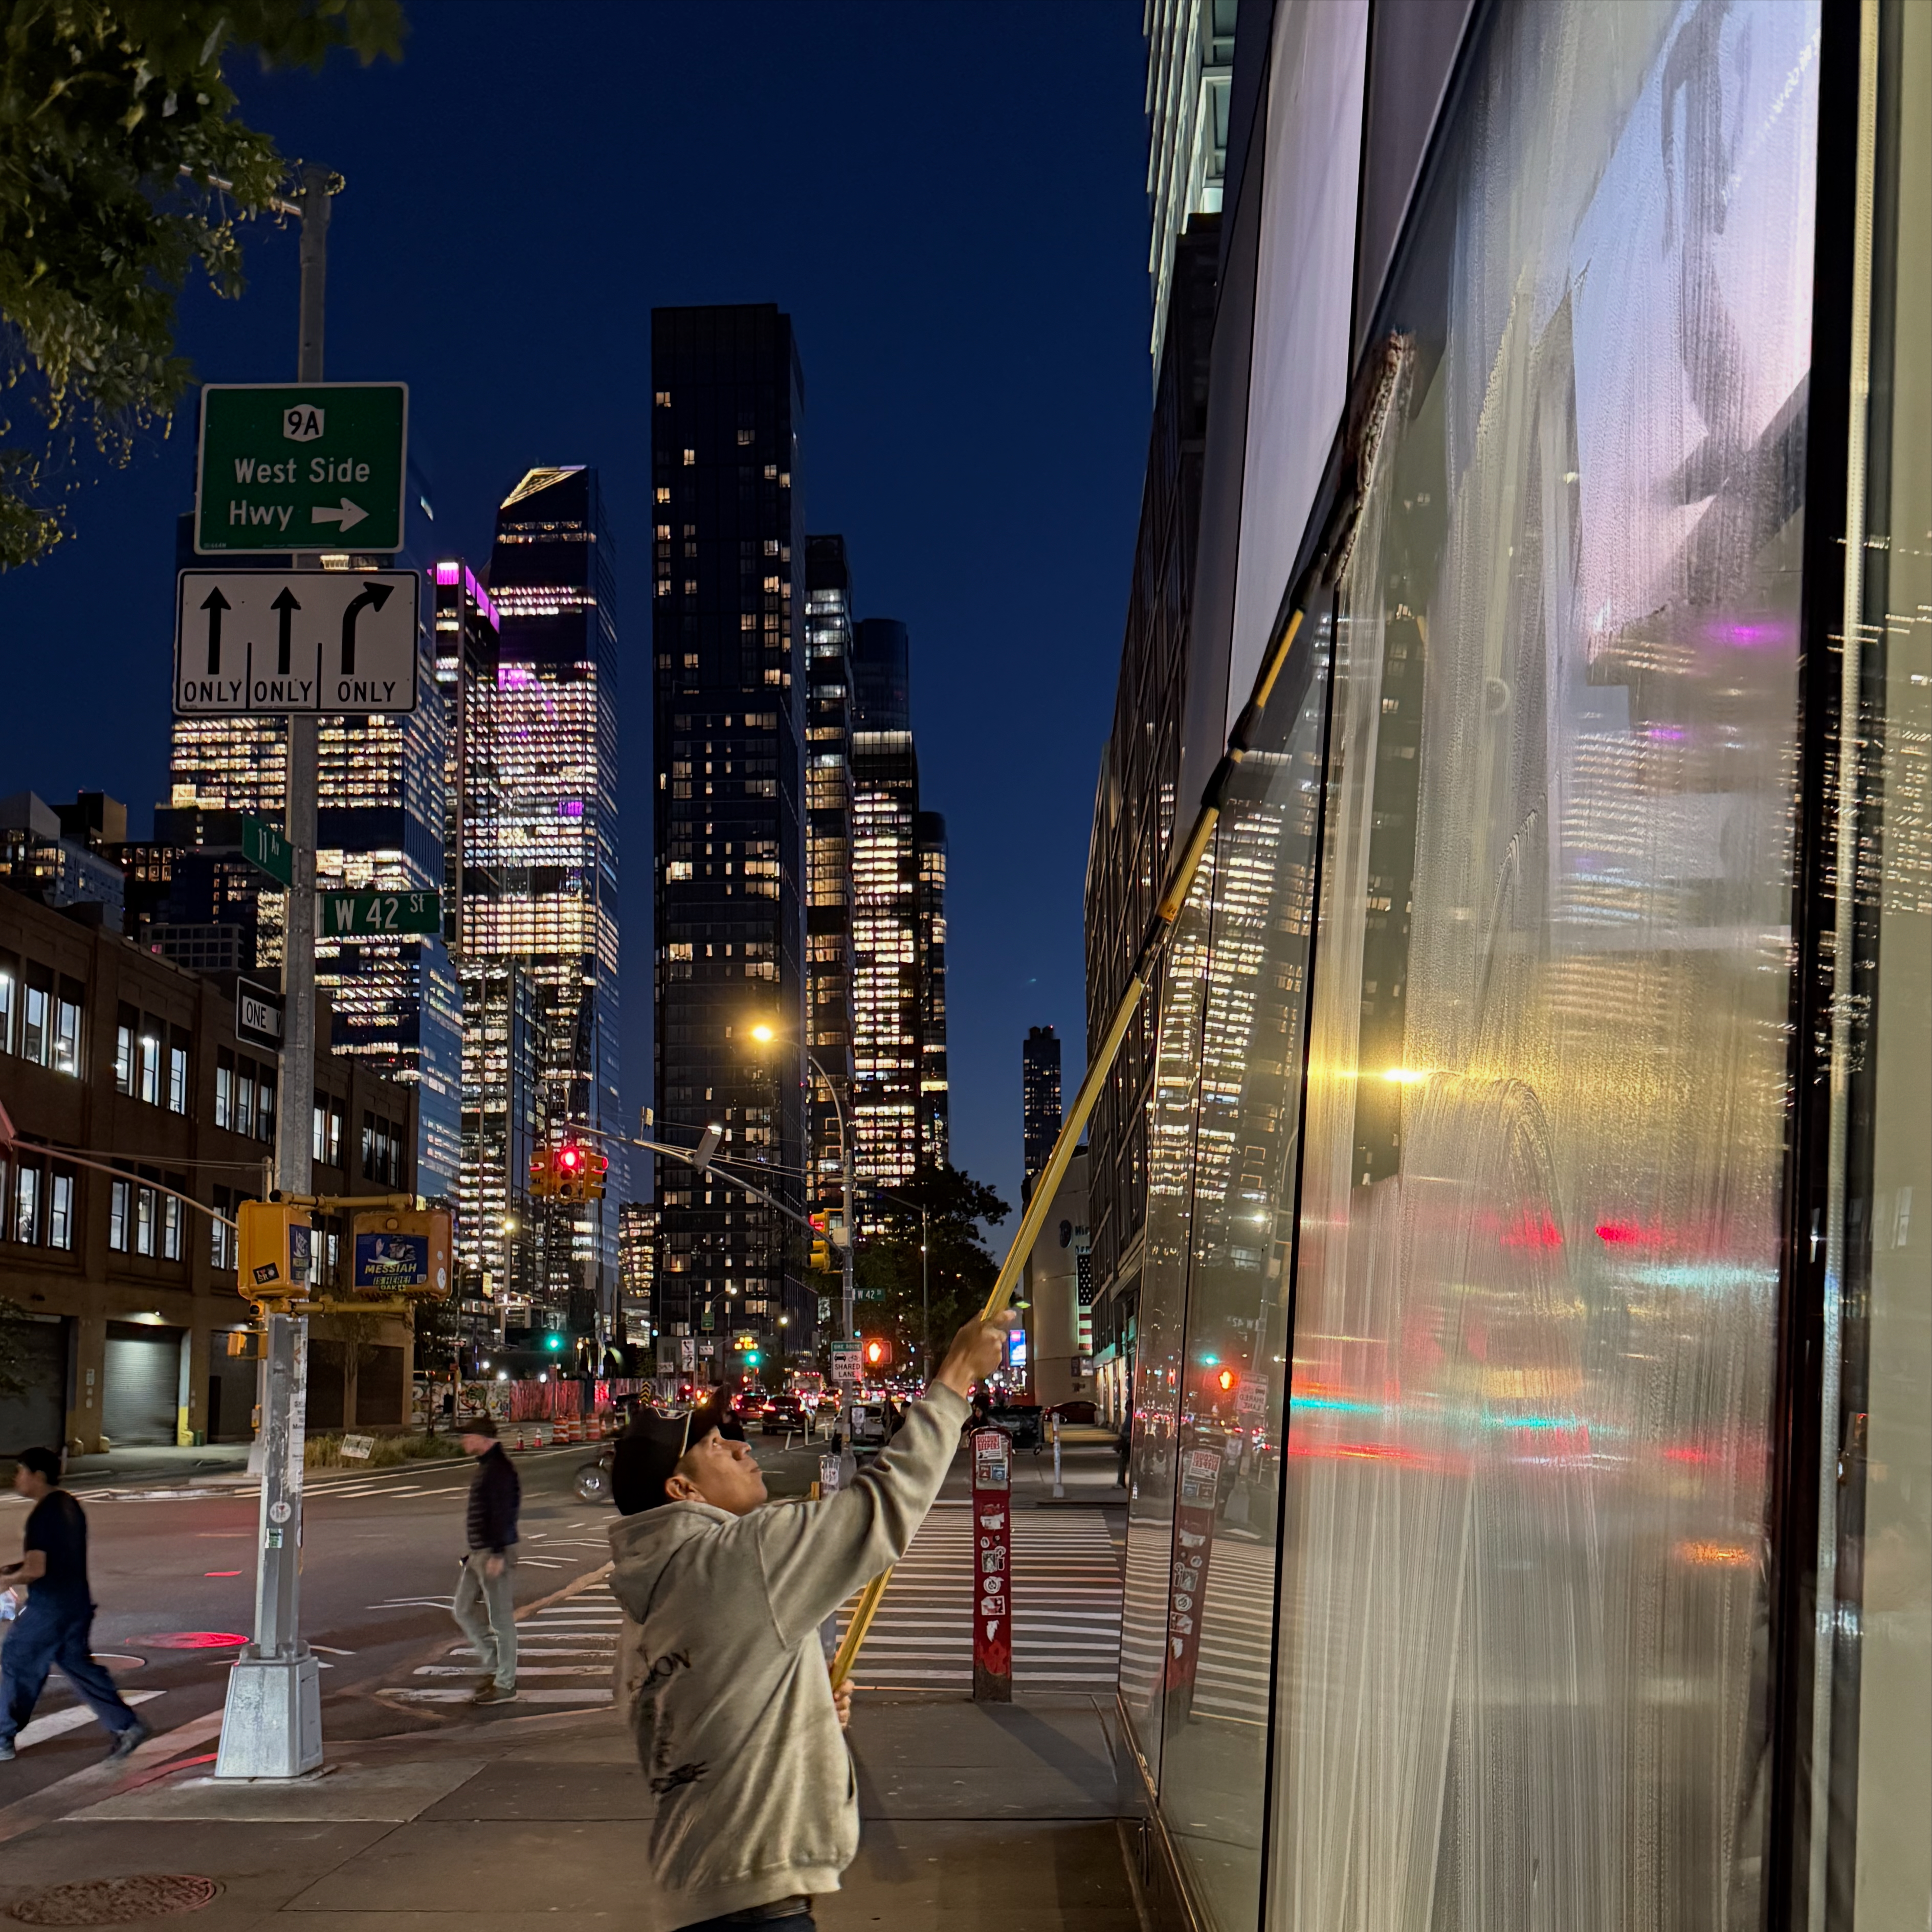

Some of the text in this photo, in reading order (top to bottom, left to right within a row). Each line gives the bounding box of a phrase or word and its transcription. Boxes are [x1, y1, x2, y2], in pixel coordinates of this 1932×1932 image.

[287, 411, 320, 435] 9A
[235, 457, 370, 483] West Side
[230, 500, 294, 531] Hwy
[184, 681, 242, 702] ONLY
[255, 681, 313, 702] ONLY
[338, 681, 395, 702] ONLY
[258, 828, 280, 863] 11 Av
[335, 894, 425, 931] W 42 St
[247, 1001, 267, 1029] ONE
[364, 1263, 417, 1274] MESSIAH
[857, 1290, 863, 1299] W
[865, 1290, 875, 1299] 42
